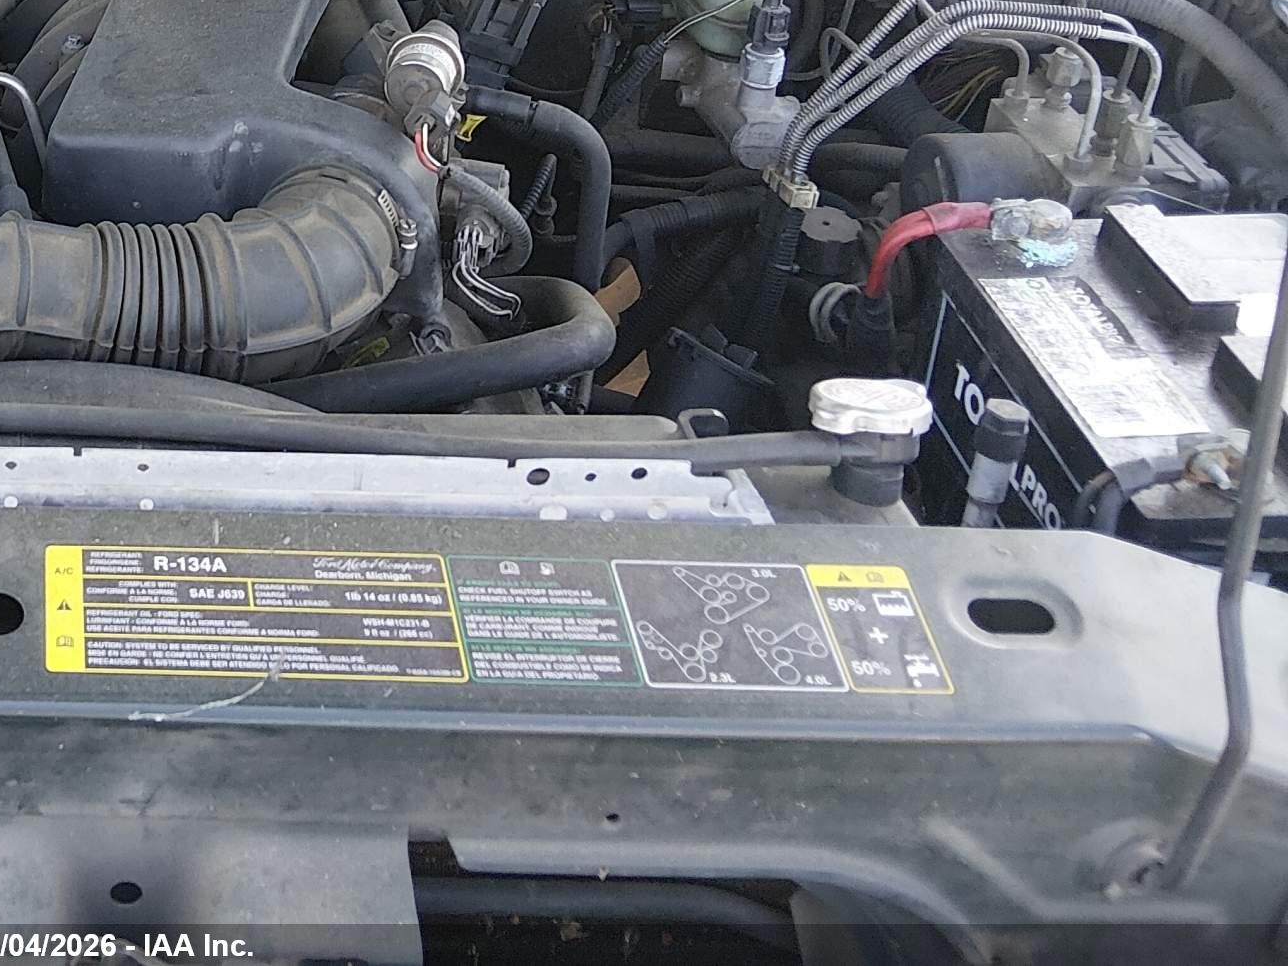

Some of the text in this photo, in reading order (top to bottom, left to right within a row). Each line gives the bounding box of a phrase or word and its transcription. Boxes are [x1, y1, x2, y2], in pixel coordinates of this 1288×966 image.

[154, 556, 227, 573] R-134A
[55, 567, 73, 575] A/C
[315, 570, 412, 582] Dearborn, Michigan
[751, 569, 777, 578] 3.0L
[189, 588, 245, 600] SAE J639
[488, 587, 508, 595] FUEL
[345, 592, 361, 601] 1lb
[363, 592, 376, 601] 14
[378, 593, 391, 602] oz
[424, 594, 442, 605] kg)
[827, 598, 866, 612] 50%
[87, 641, 123, 649] CAUTION:
[158, 642, 168, 650] TO
[851, 661, 891, 676] 50%
[805, 676, 832, 685] 4.0L
